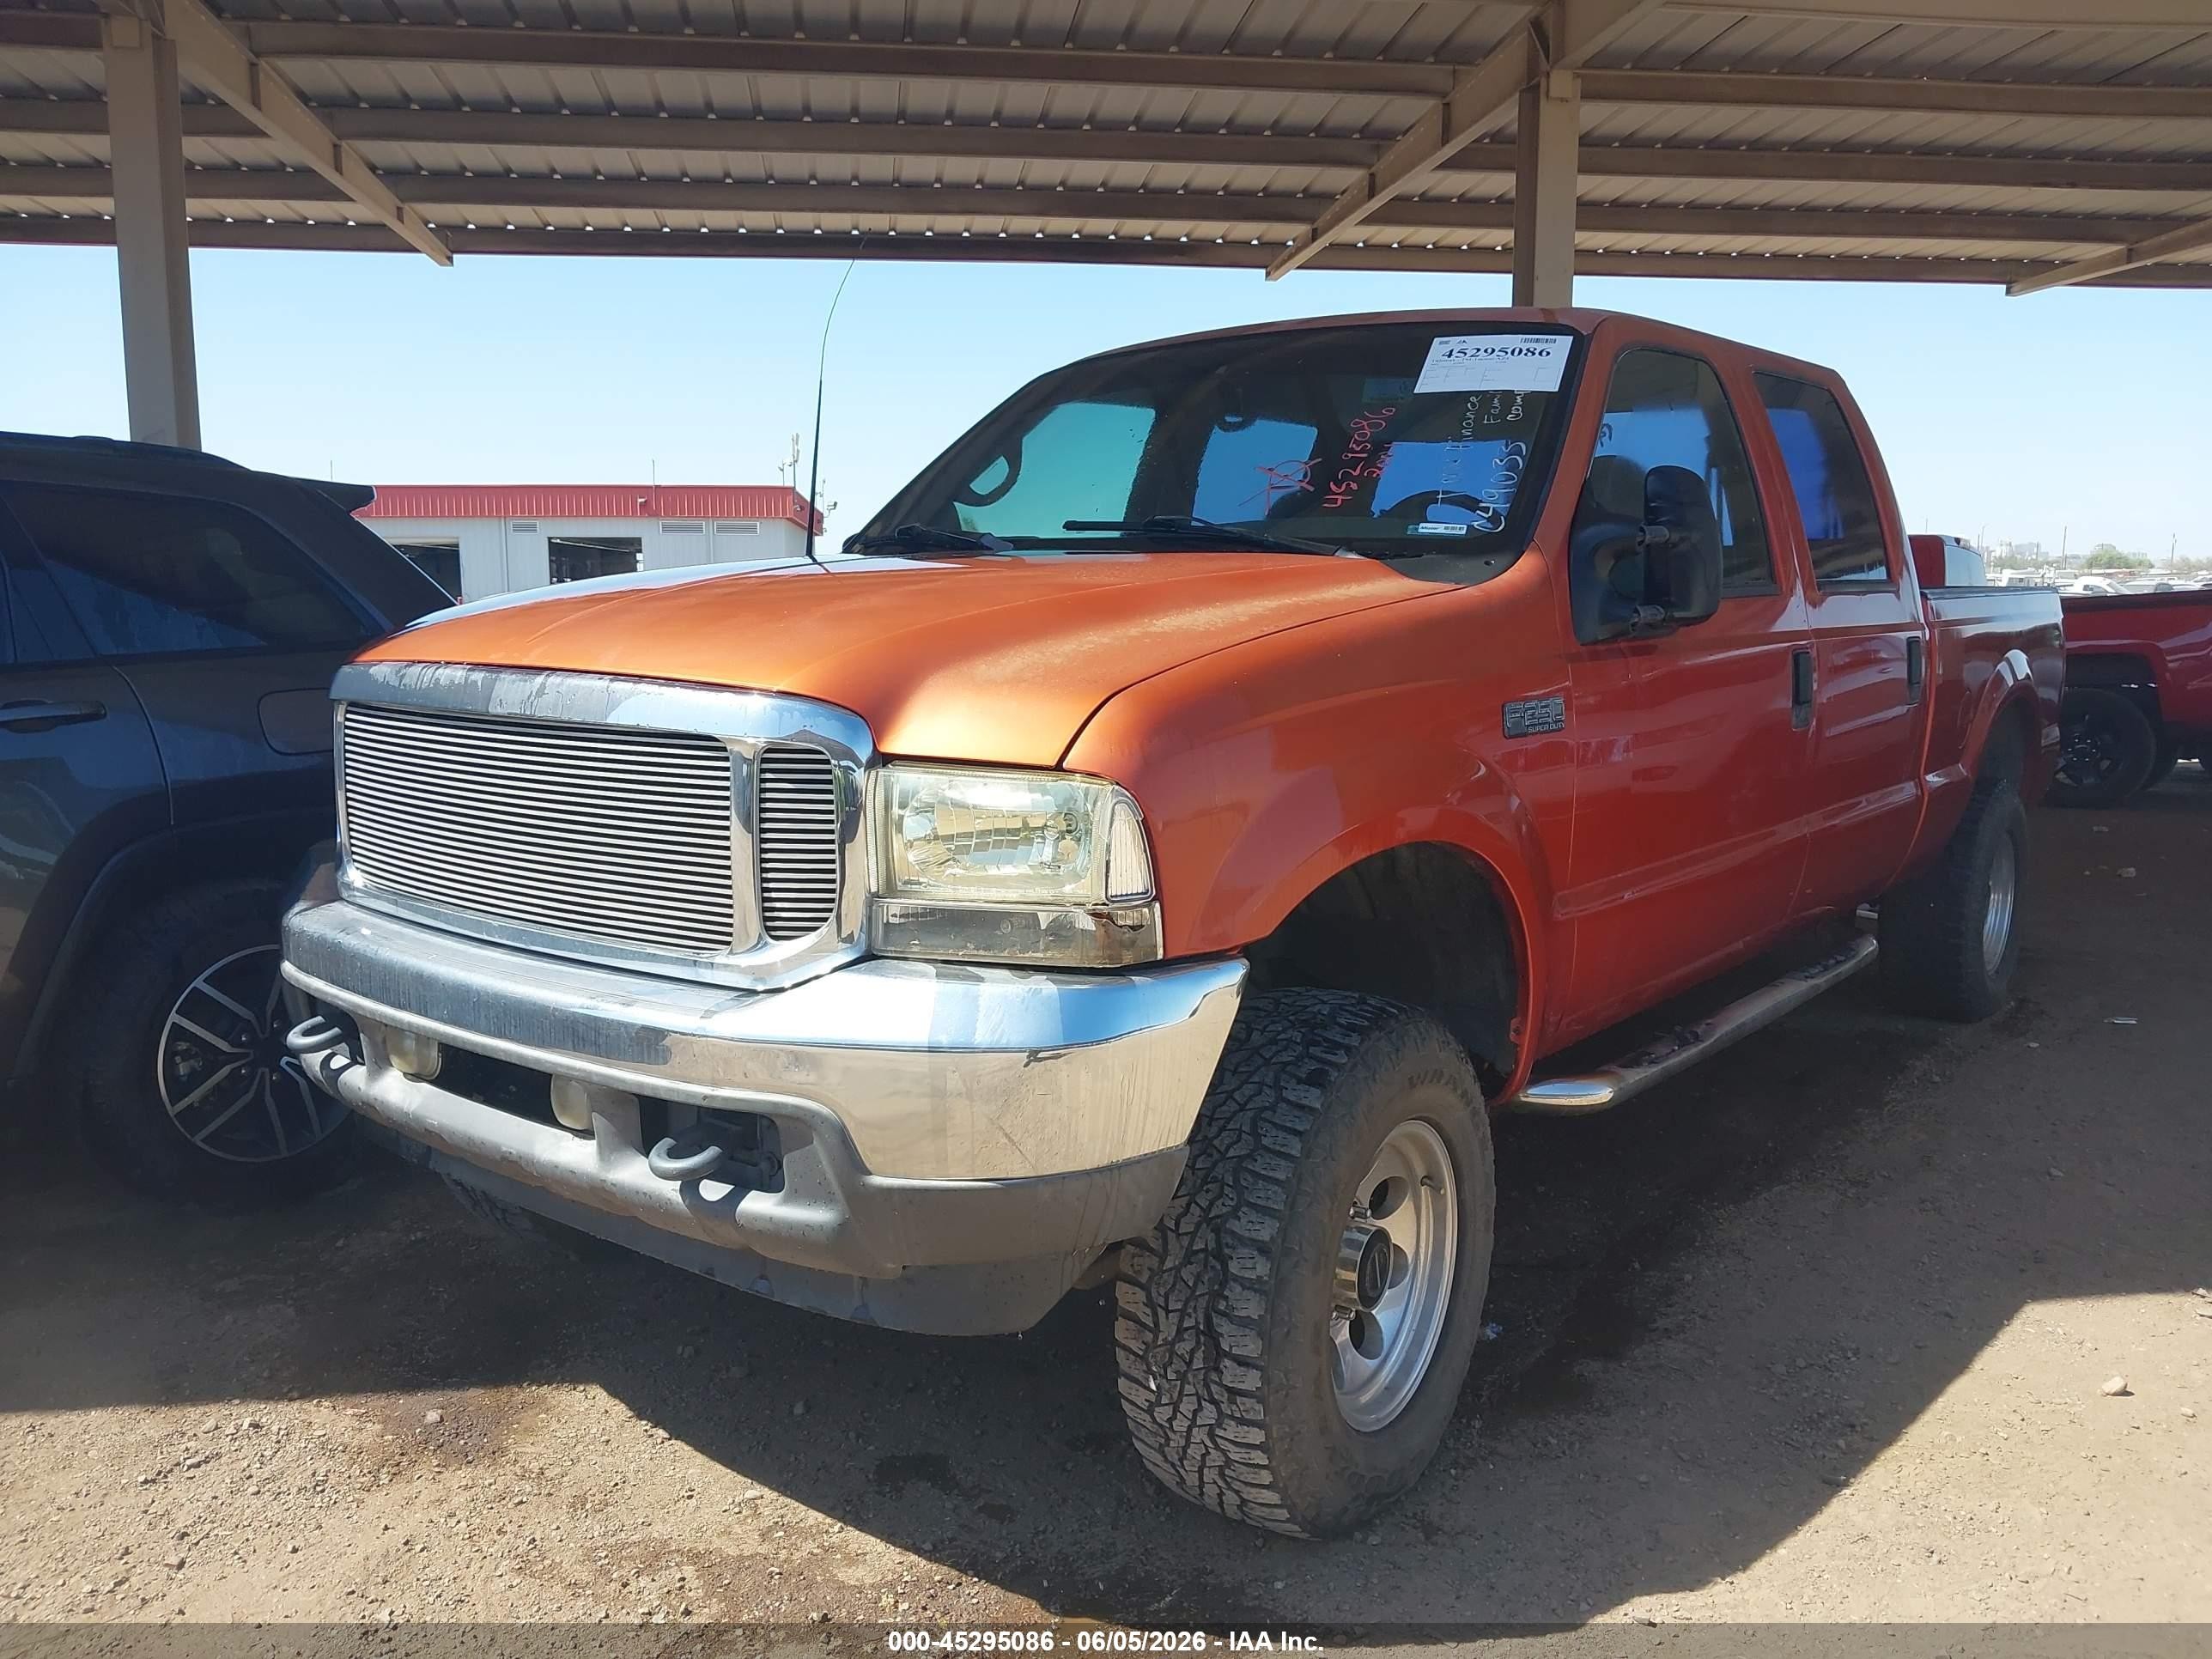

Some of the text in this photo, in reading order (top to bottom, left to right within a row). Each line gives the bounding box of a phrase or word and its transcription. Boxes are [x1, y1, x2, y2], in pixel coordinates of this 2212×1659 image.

[1441, 346, 1553, 359] 45295086
[1322, 408, 1395, 507] 45295086
[1528, 724, 1549, 733] SUPER
